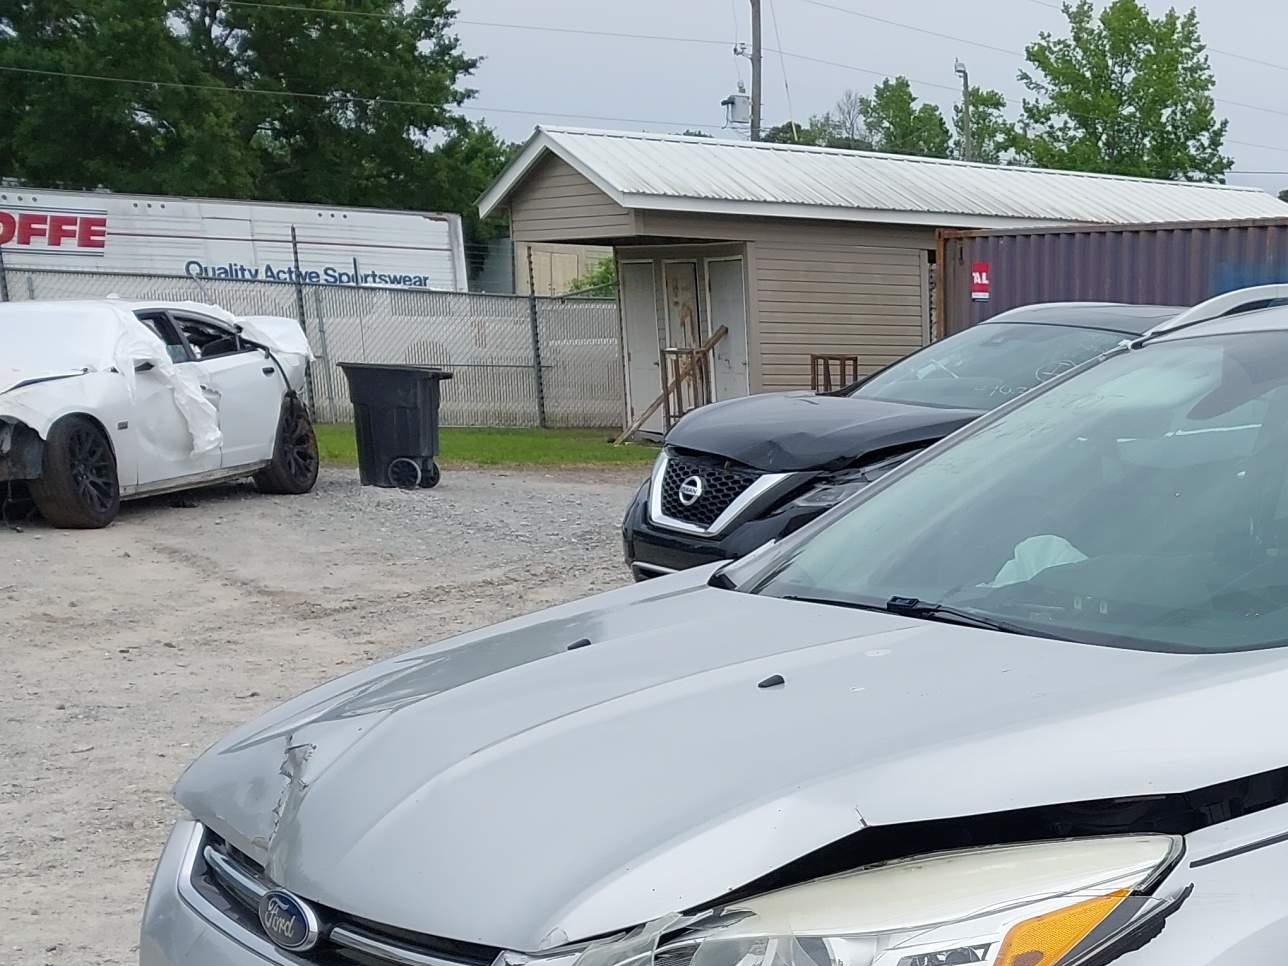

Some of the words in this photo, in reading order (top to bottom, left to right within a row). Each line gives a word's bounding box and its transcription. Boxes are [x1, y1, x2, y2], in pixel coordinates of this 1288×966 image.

[185, 260, 259, 280] Quality
[324, 266, 430, 288] Sportswear
[265, 897, 296, 938] Ford
